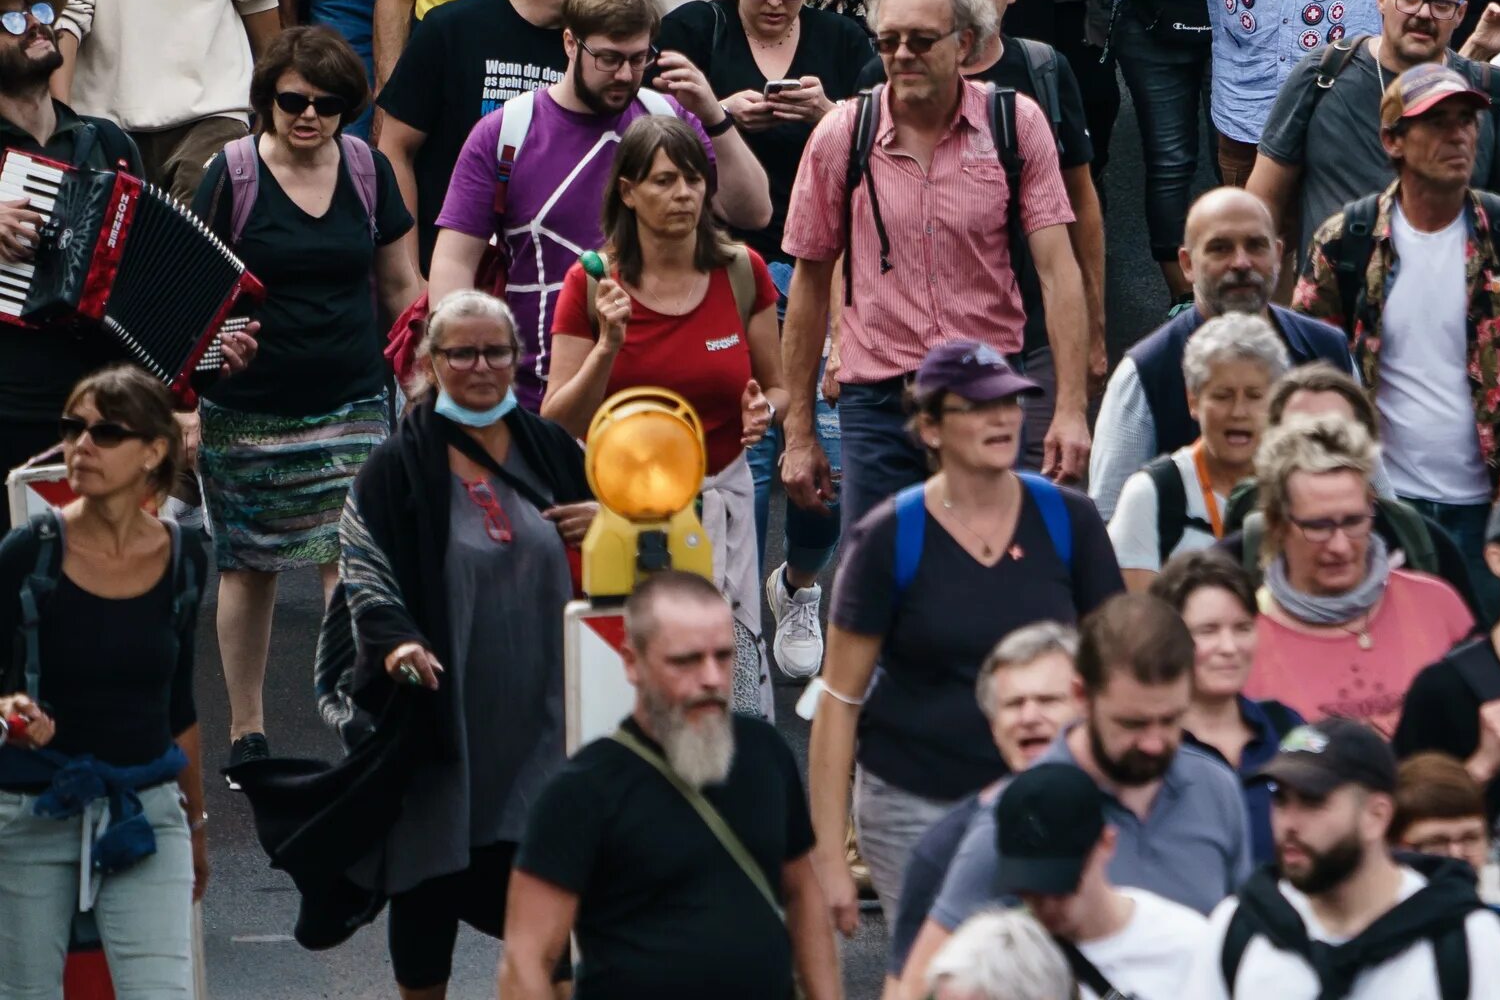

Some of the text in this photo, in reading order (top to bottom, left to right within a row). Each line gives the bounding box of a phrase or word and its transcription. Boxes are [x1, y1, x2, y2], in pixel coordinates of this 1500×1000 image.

[484, 76, 498, 87] es
[499, 76, 522, 89] geht
[485, 59, 566, 84] Wenn du den
[107, 193, 130, 249] HOHNER
